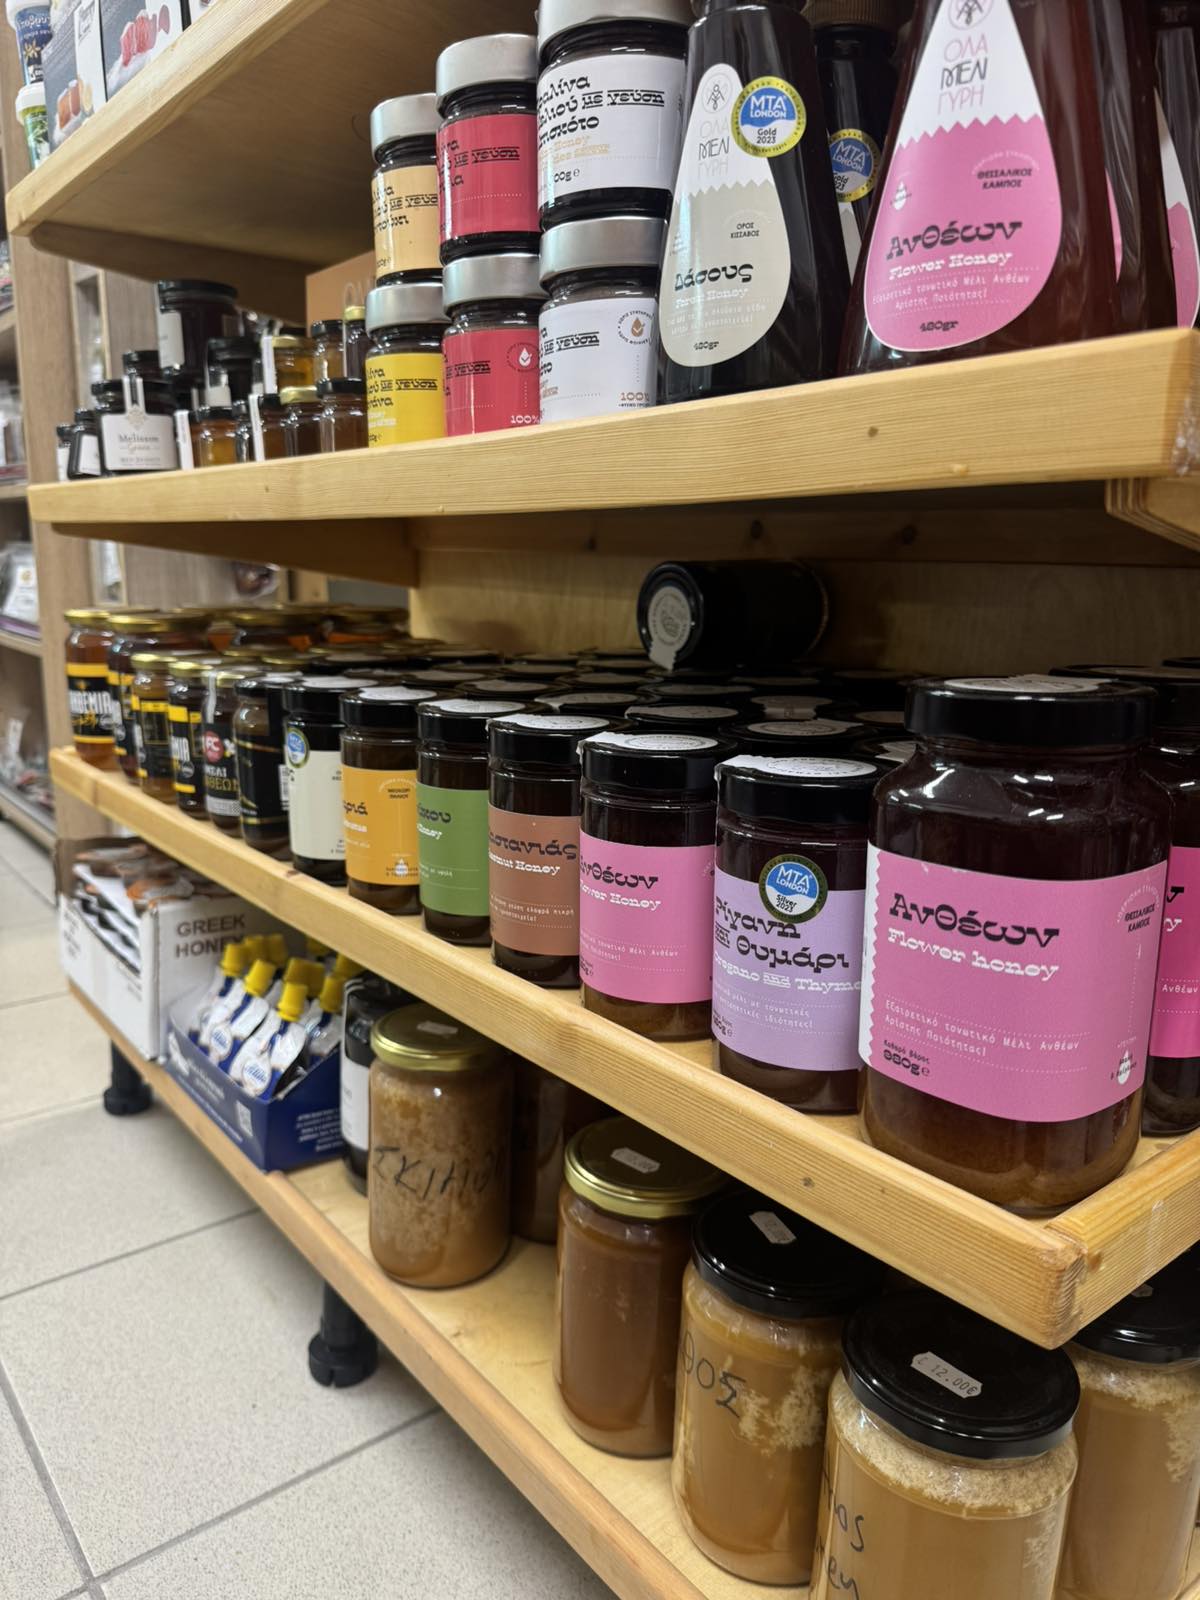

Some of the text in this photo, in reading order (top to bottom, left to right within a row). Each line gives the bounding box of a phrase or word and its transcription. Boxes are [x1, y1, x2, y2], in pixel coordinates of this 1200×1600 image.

[750, 94, 787, 111] MTA
[749, 109, 787, 119] LONDON
[756, 135, 777, 145] 2023
[757, 128, 777, 136] Gold
[832, 153, 864, 172] LONDON
[835, 140, 867, 166] MTA
[982, 179, 1022, 190] ΚΑΜΠΟΣ
[404, 193, 438, 208] γεύσ
[886, 221, 1023, 261] Ανθέων
[888, 251, 1013, 281] Flower Honey
[674, 263, 754, 292] Δάσους
[515, 860, 561, 876] Honey
[777, 865, 811, 889] MTA
[776, 877, 809, 895] LONDON
[610, 891, 661, 911] Honey
[775, 900, 794, 913] 2023
[776, 894, 798, 908] Silver
[176, 914, 246, 938] GREEK
[715, 895, 801, 939] Ρίγανη
[889, 892, 1060, 949] Ανθέων
[736, 934, 850, 974] Θυμάρι
[887, 927, 1060, 982] Flower honey
[1162, 983, 1199, 995] Ανθέων
[884, 1013, 987, 1057] Αρίστης Ποιότητας!
[885, 999, 1080, 1051] Εξαιρετικό τονωτικό Μέλι Ανθέων
